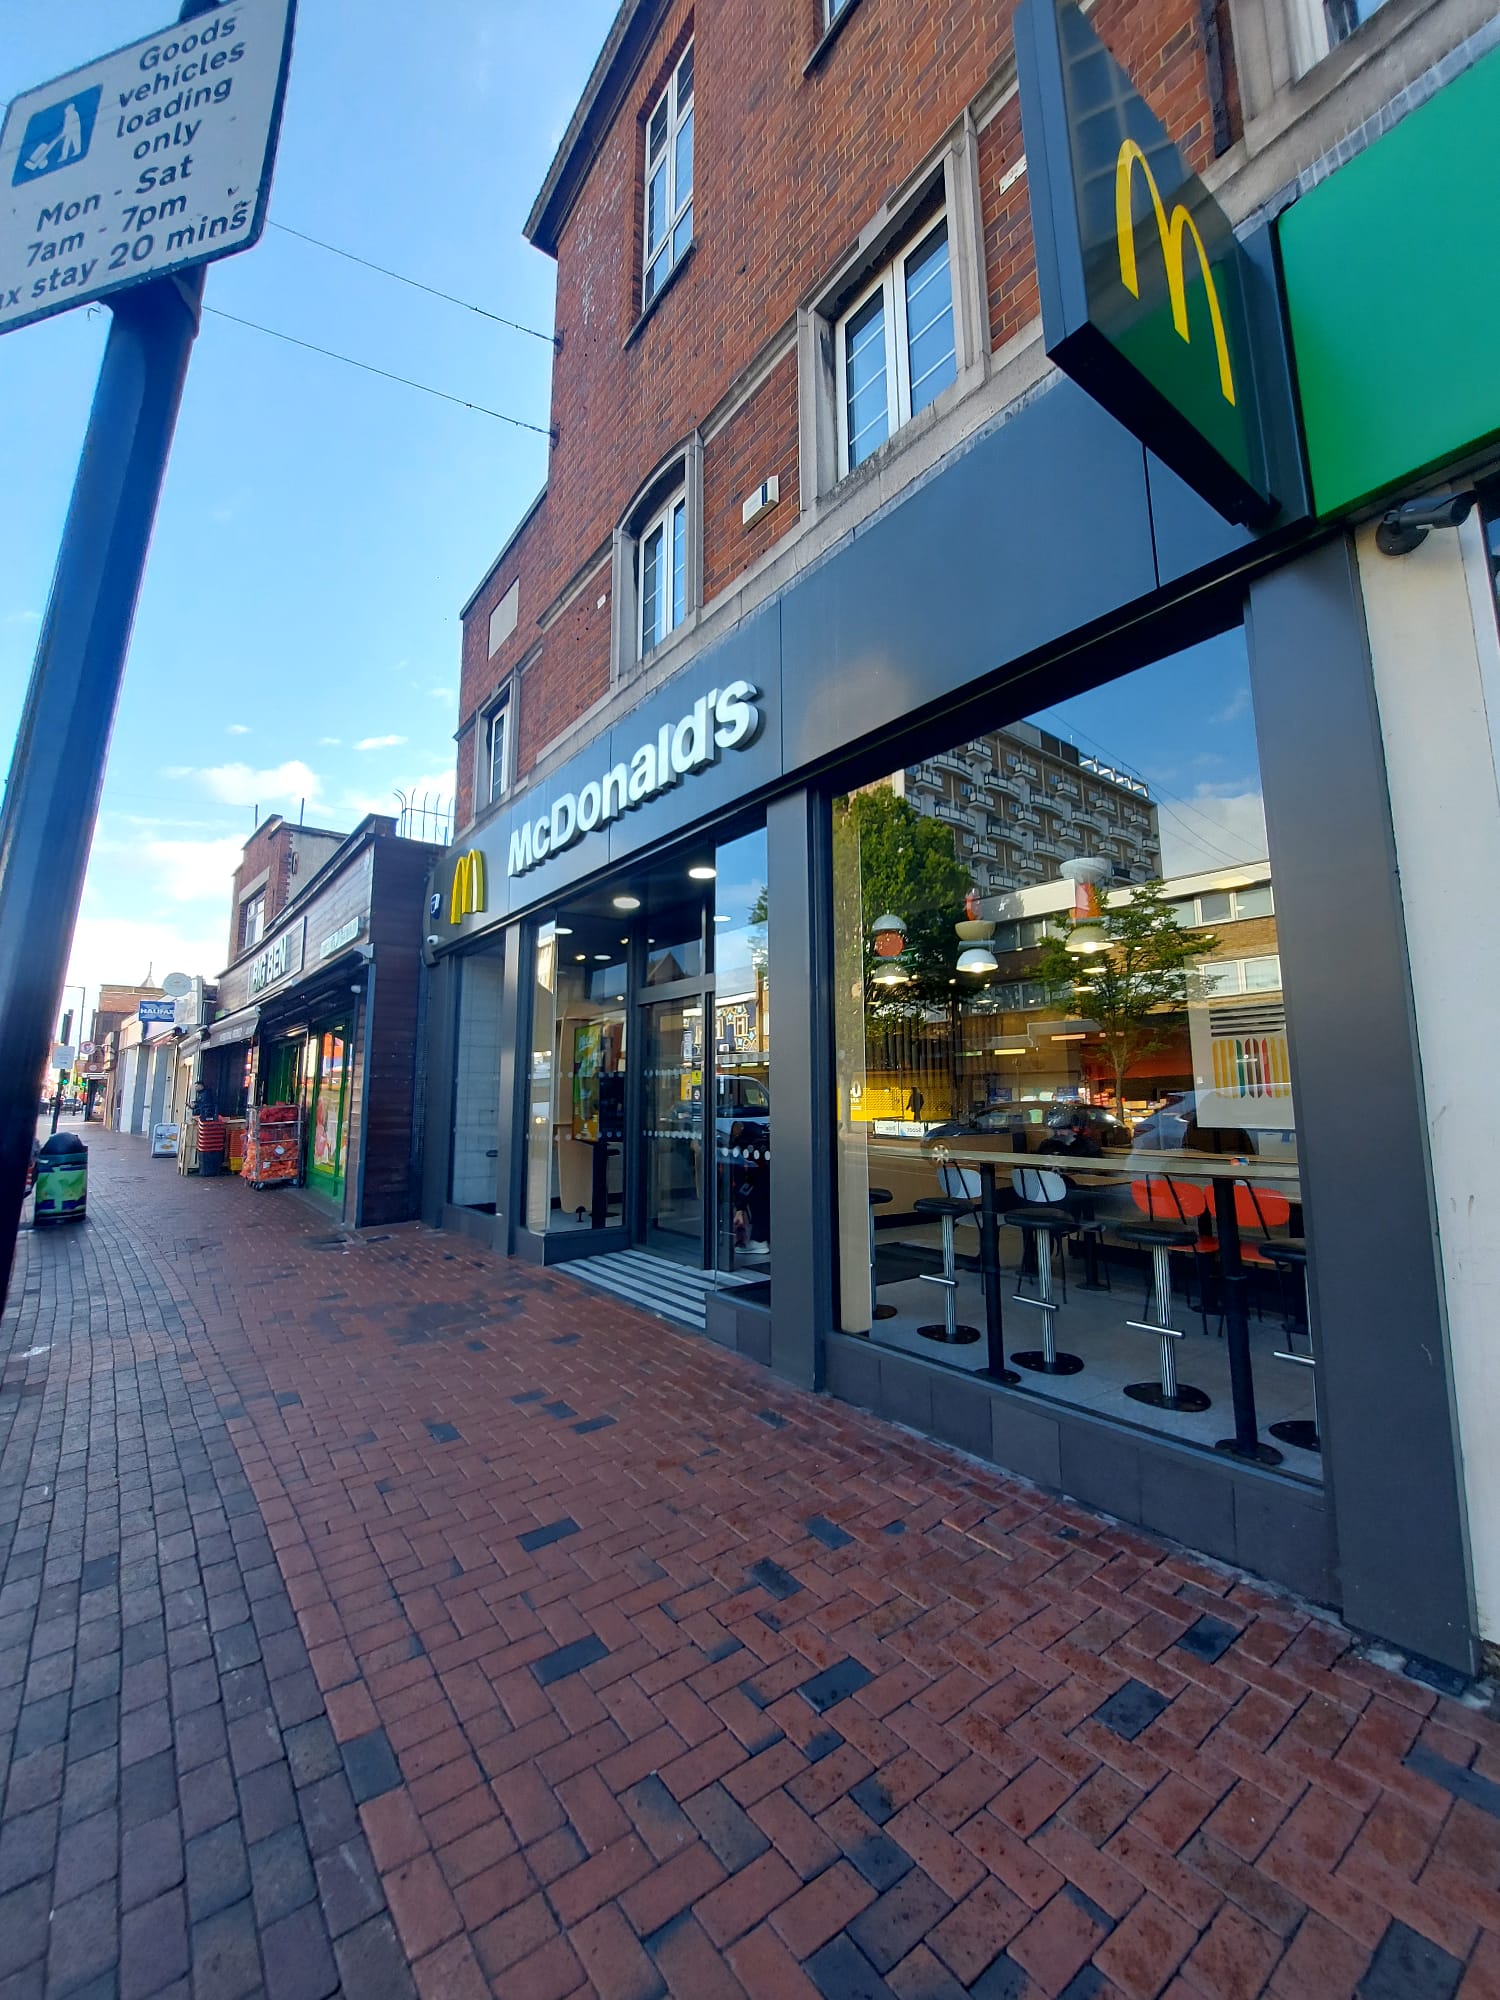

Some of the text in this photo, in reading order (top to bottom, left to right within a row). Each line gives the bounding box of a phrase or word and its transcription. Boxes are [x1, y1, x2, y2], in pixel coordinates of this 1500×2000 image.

[119, 41, 246, 108] vehicles
[139, 17, 237, 71] Goods
[116, 77, 233, 138] loading
[133, 119, 202, 160] only
[36, 194, 101, 232] Mon
[135, 153, 193, 194] Sat
[27, 231, 85, 268] 7am
[121, 195, 187, 232] 7pm
[31, 258, 98, 298] stay
[108, 234, 154, 271] 20
[166, 208, 248, 251] mins
[507, 680, 759, 877] McDonald's
[266, 934, 287, 985] BEN
[140, 1005, 175, 1016] HALIFAX
